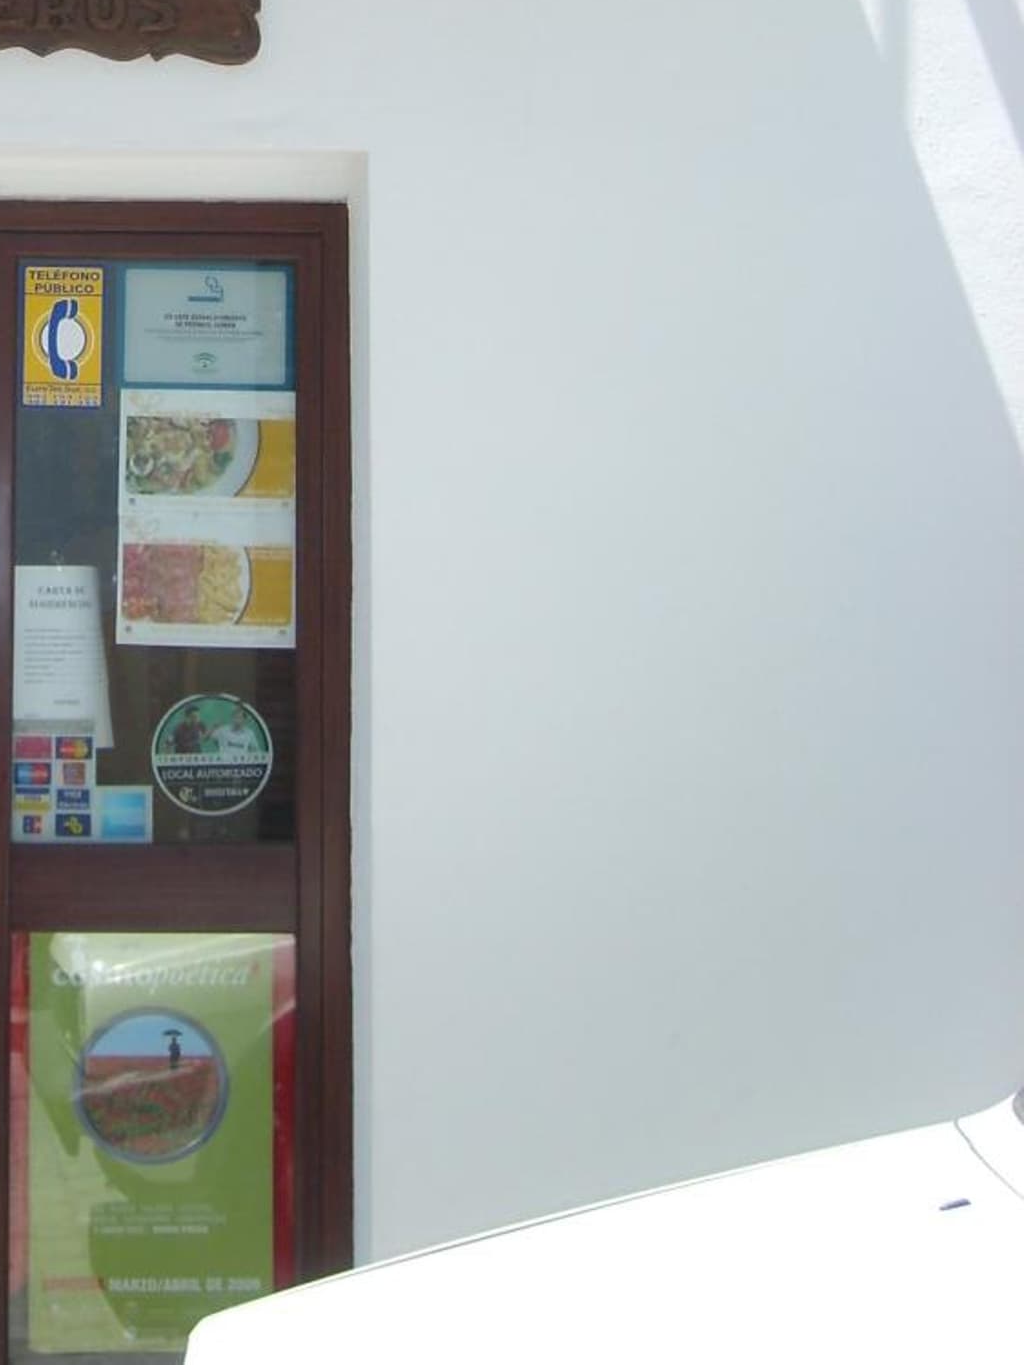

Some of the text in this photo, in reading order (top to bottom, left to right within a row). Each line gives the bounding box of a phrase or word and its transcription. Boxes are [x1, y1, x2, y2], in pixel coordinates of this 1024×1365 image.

[28, 269, 100, 281] TELÉFONO
[162, 768, 263, 780] LOCAL AUTORIZADO
